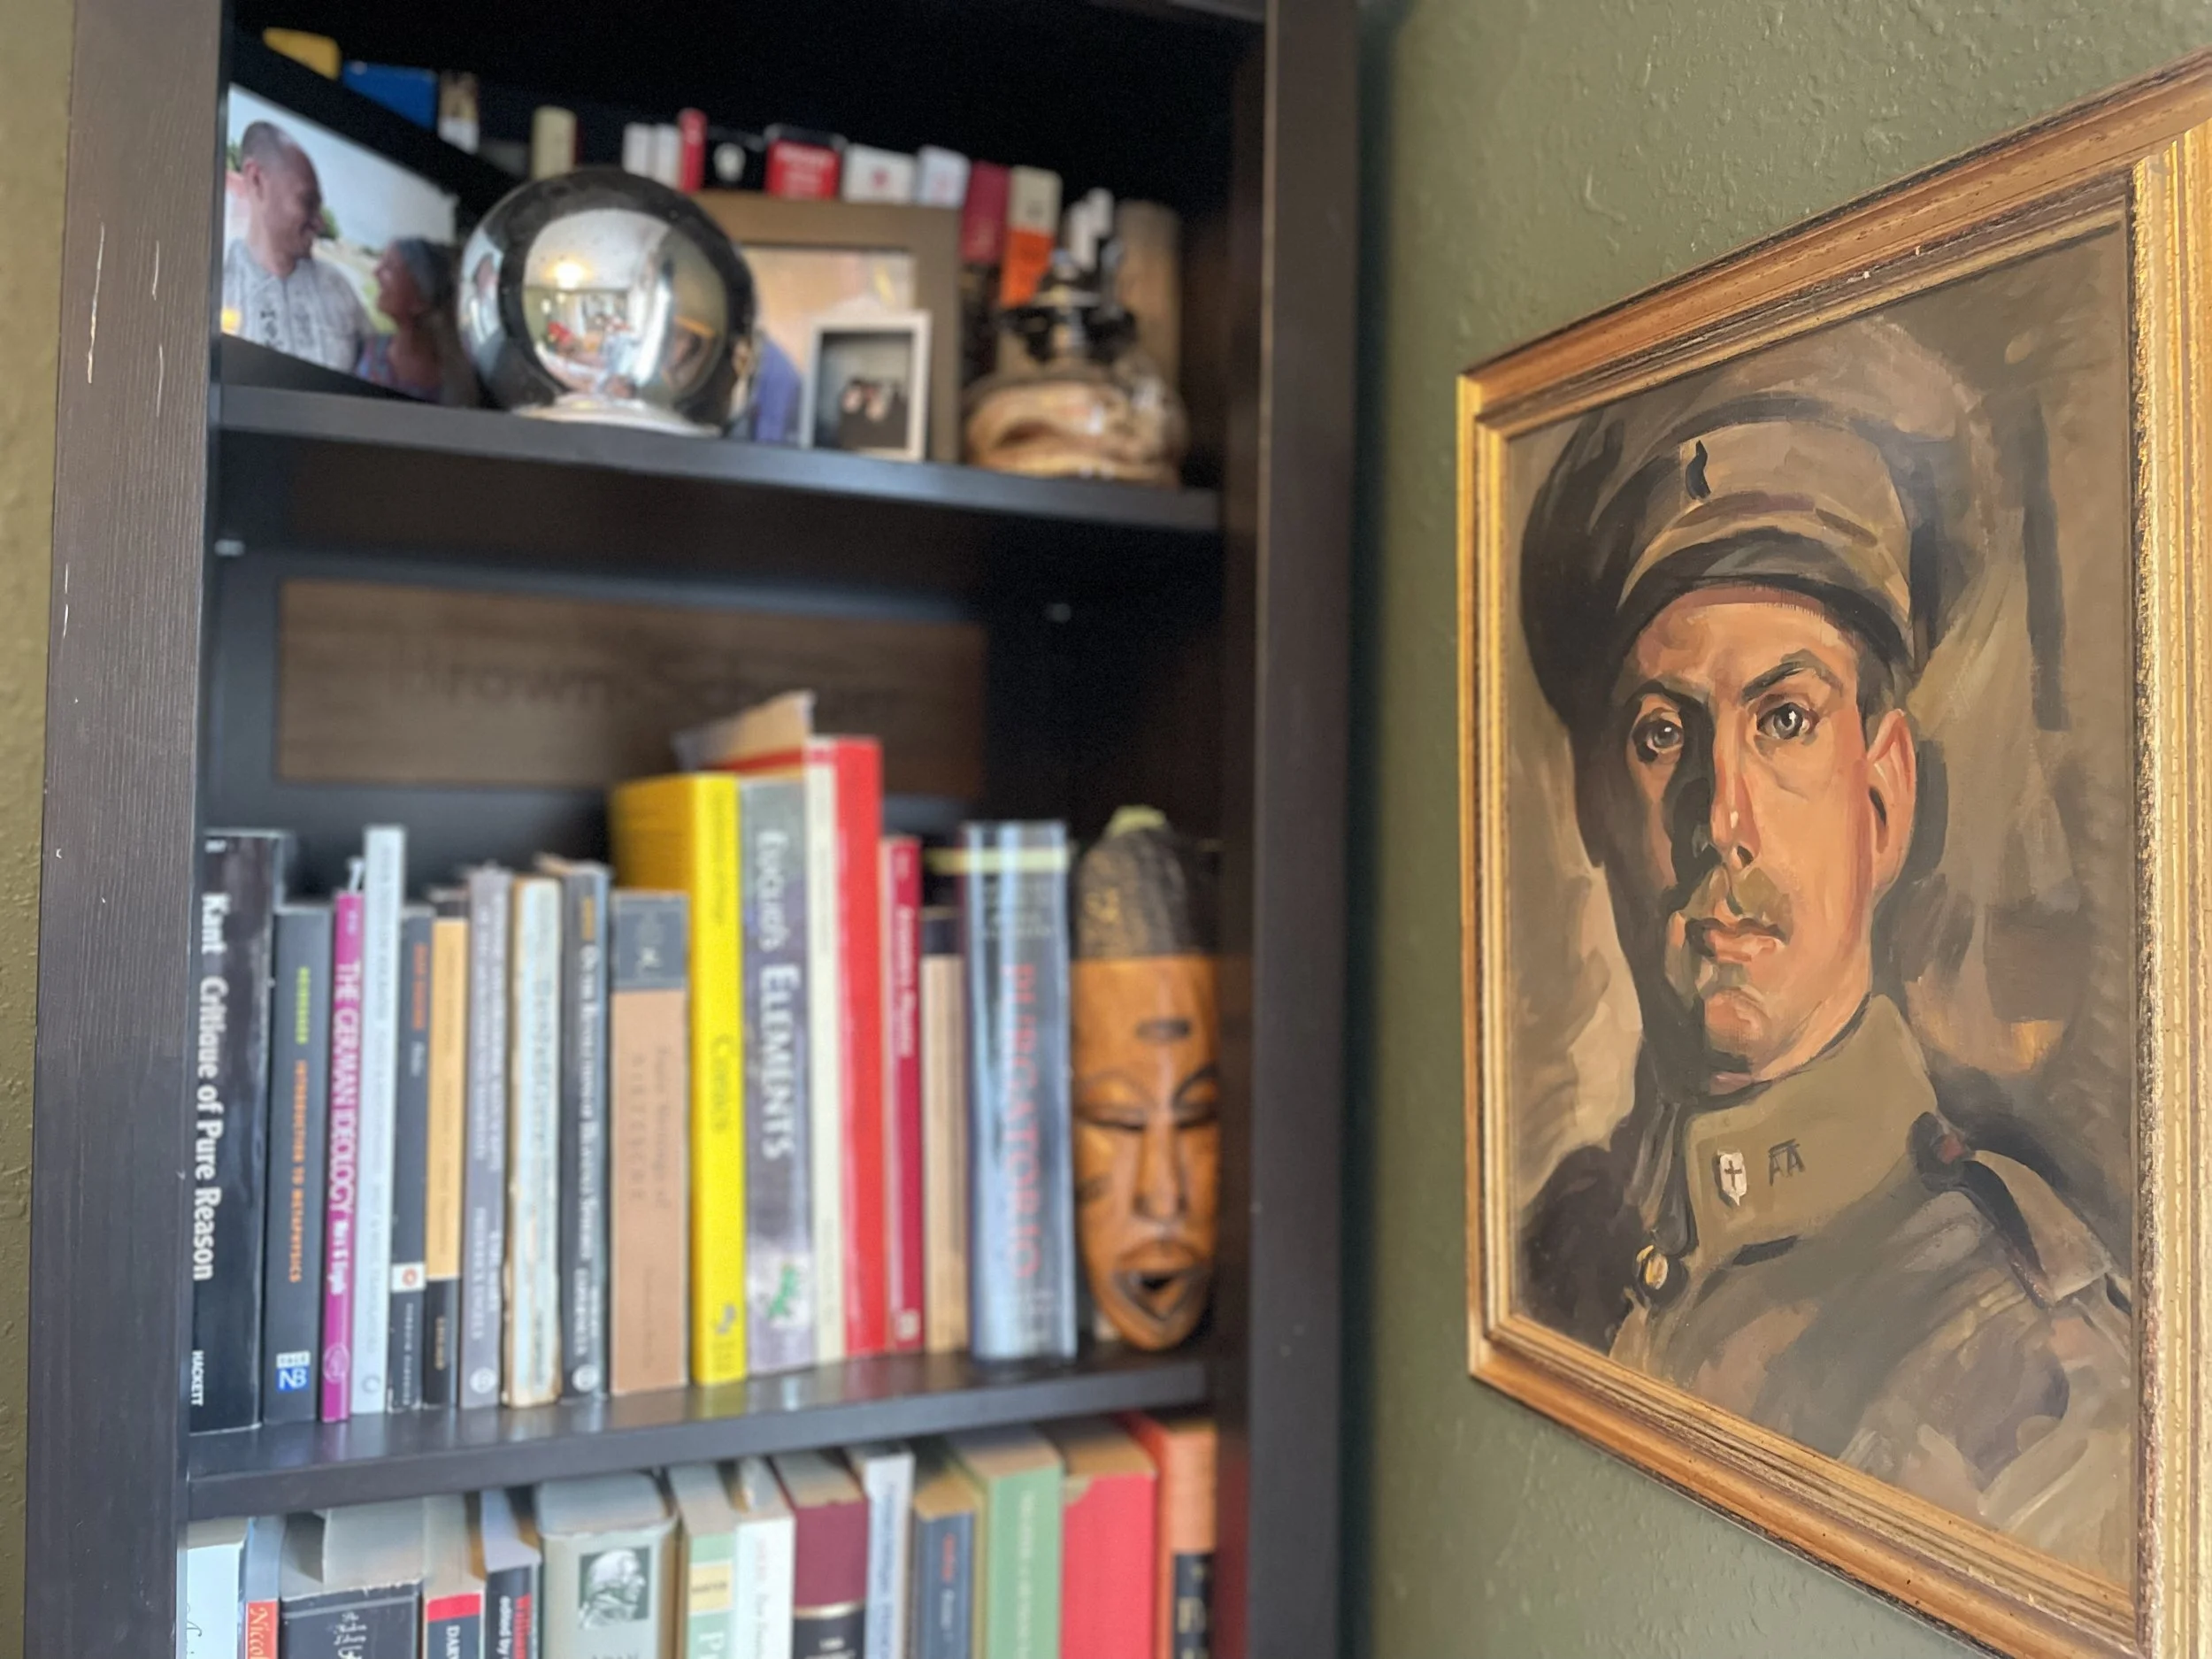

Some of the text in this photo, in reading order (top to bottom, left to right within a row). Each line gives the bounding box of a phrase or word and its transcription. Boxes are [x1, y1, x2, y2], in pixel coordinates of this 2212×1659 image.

[201, 891, 231, 955] Kant
[334, 960, 362, 1002] THE
[331, 1007, 360, 1105] GERMAN
[196, 1084, 225, 1113] of
[193, 1119, 224, 1180] Pure
[329, 1109, 358, 1213] IDEOLOGY
[192, 1187, 222, 1281] Reason
[190, 1349, 205, 1407] HACKETT
[279, 1369, 307, 1390] NB
